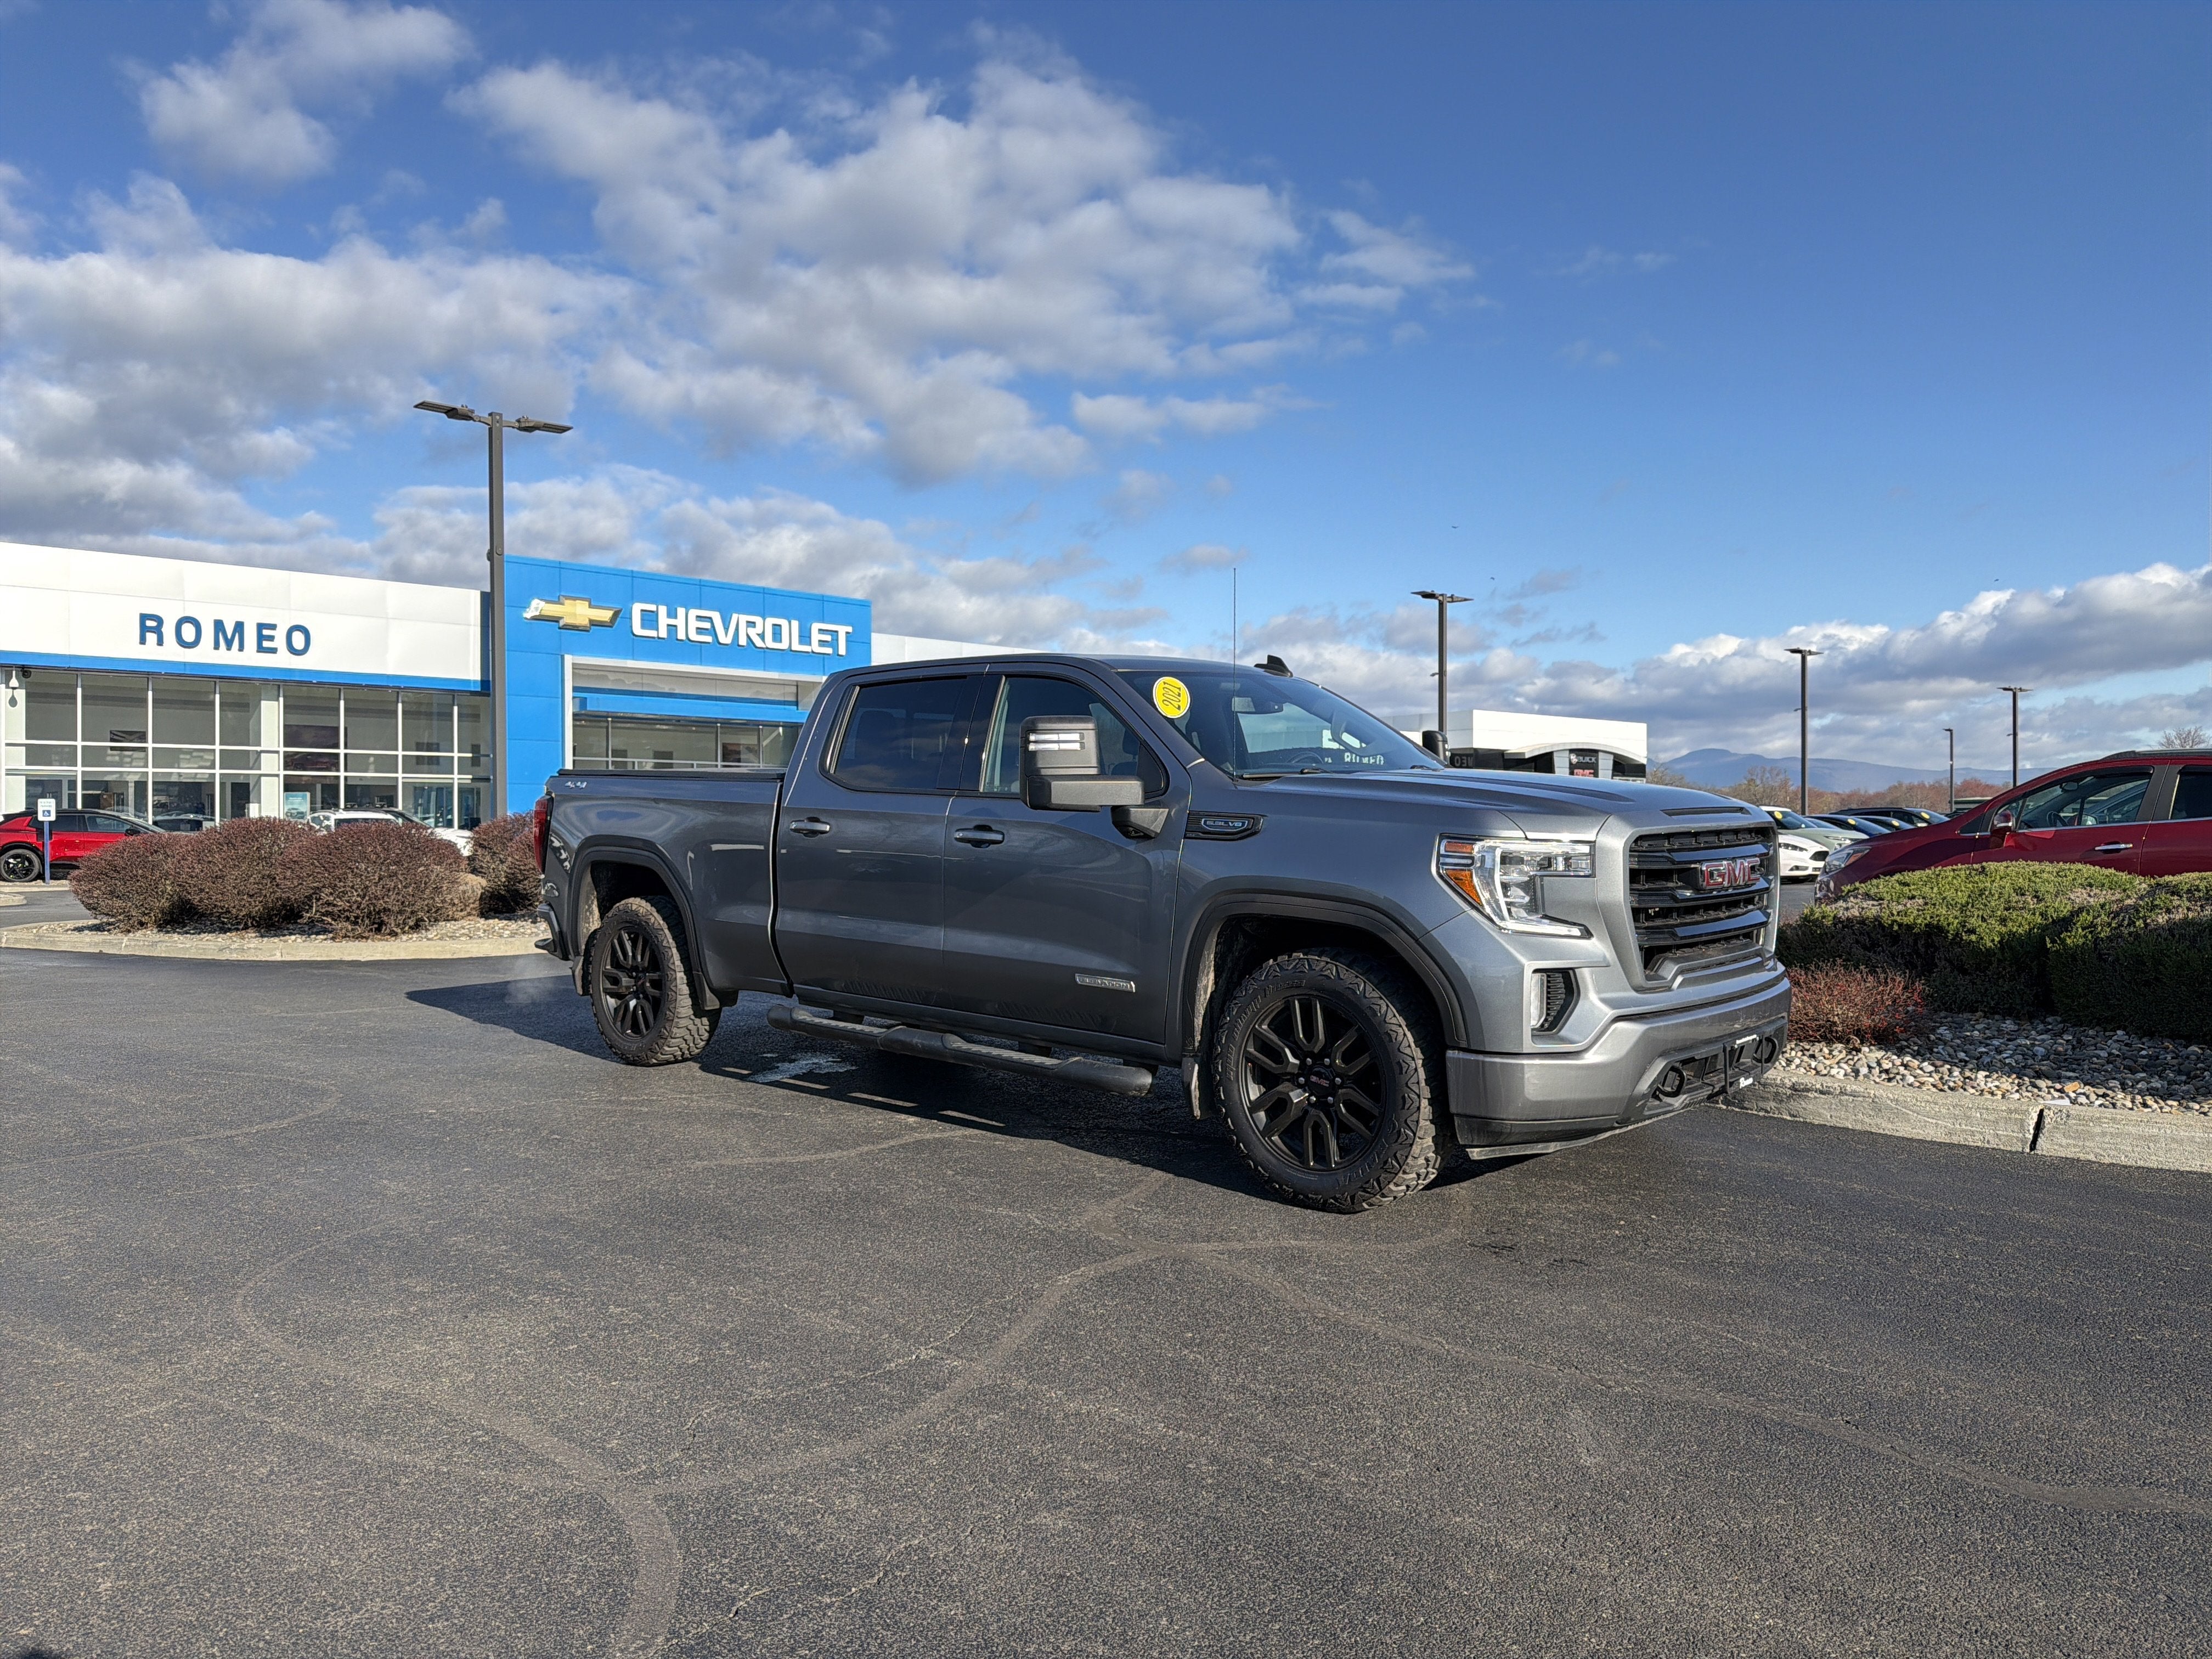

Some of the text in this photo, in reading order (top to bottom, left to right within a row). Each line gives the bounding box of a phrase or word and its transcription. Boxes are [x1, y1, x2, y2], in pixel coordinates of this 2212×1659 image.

[139, 612, 311, 656] ROMEO
[631, 602, 852, 657] CHEVROLET
[1162, 681, 1181, 711] 2021
[1573, 769, 1594, 777] GMC
[1702, 857, 1760, 888] GMC
